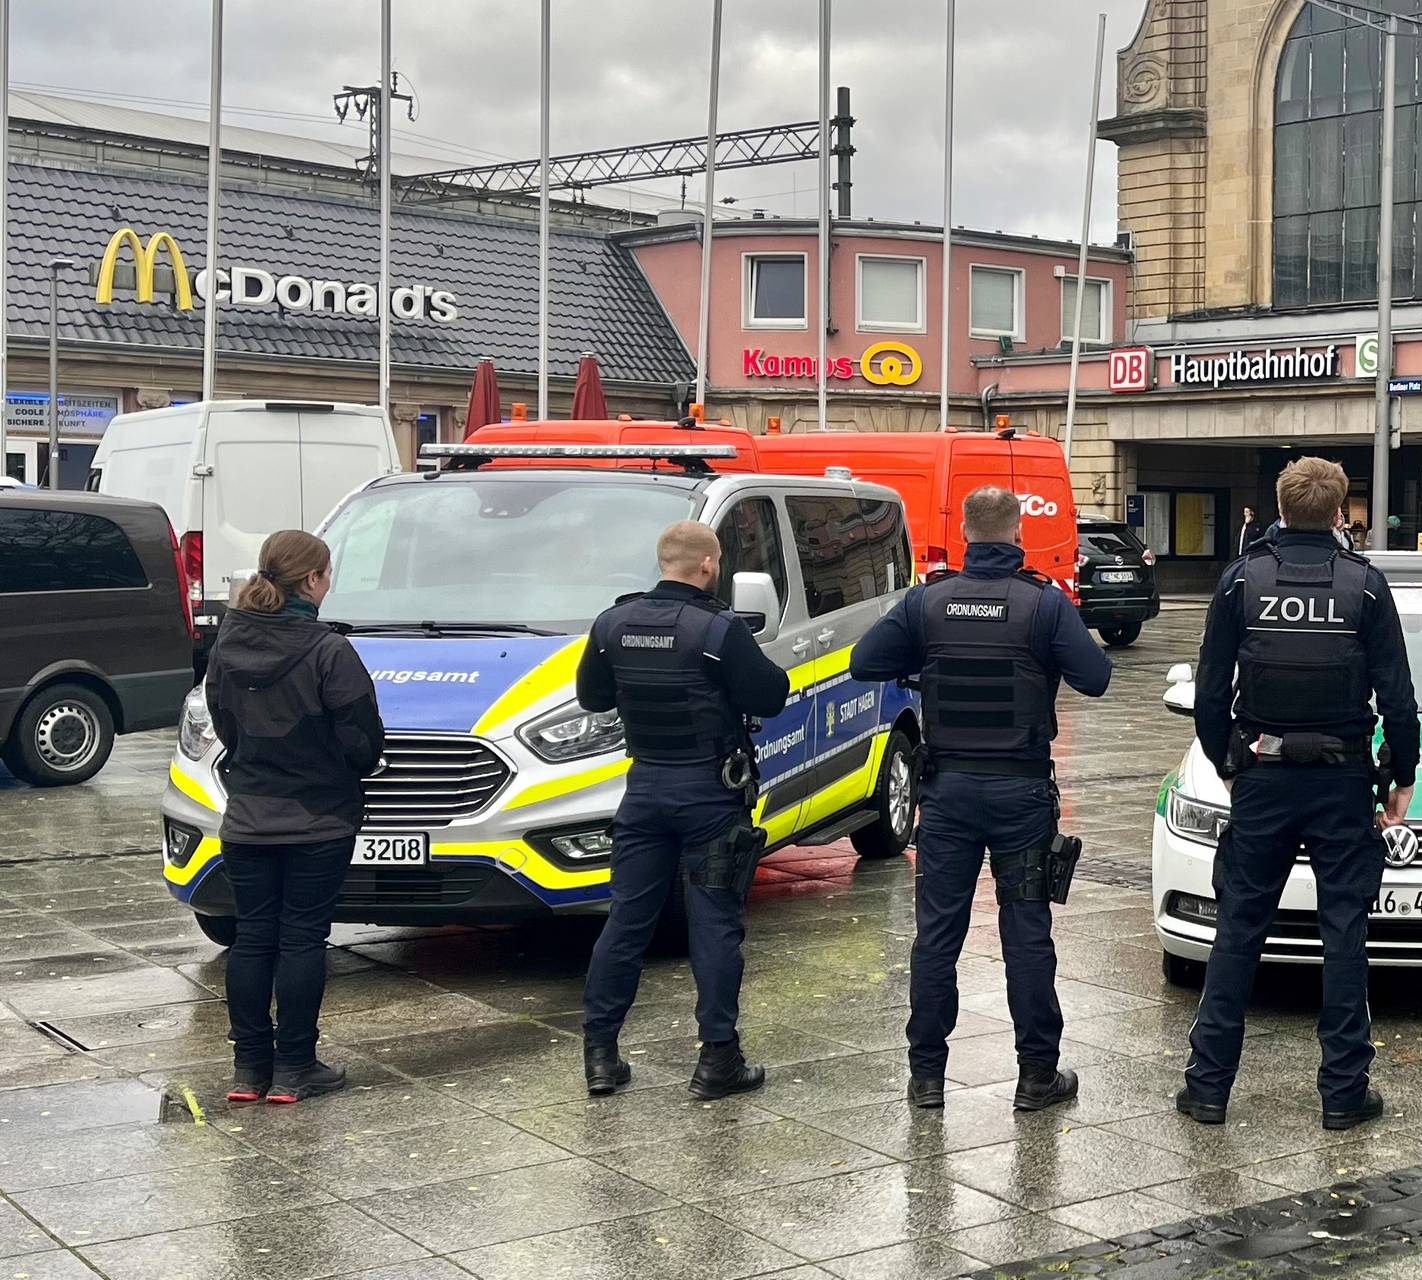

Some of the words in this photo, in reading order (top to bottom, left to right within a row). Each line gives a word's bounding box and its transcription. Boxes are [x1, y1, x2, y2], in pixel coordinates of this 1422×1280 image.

[743, 348, 853, 384] Kamps
[1112, 354, 1144, 385] DB
[1170, 344, 1336, 388] Hauptbahnhof
[7, 418, 44, 426] SICHERE
[15, 408, 44, 416] COOLE
[946, 602, 1004, 618] ORDNUNGSAMT
[1259, 596, 1344, 623] ZOLL
[621, 634, 674, 649] ORDNUNGSAMT
[839, 697, 858, 724] STADT
[857, 688, 875, 714] HAGEN
[754, 724, 805, 764] Ordnungsamt
[362, 838, 421, 861] 3208
